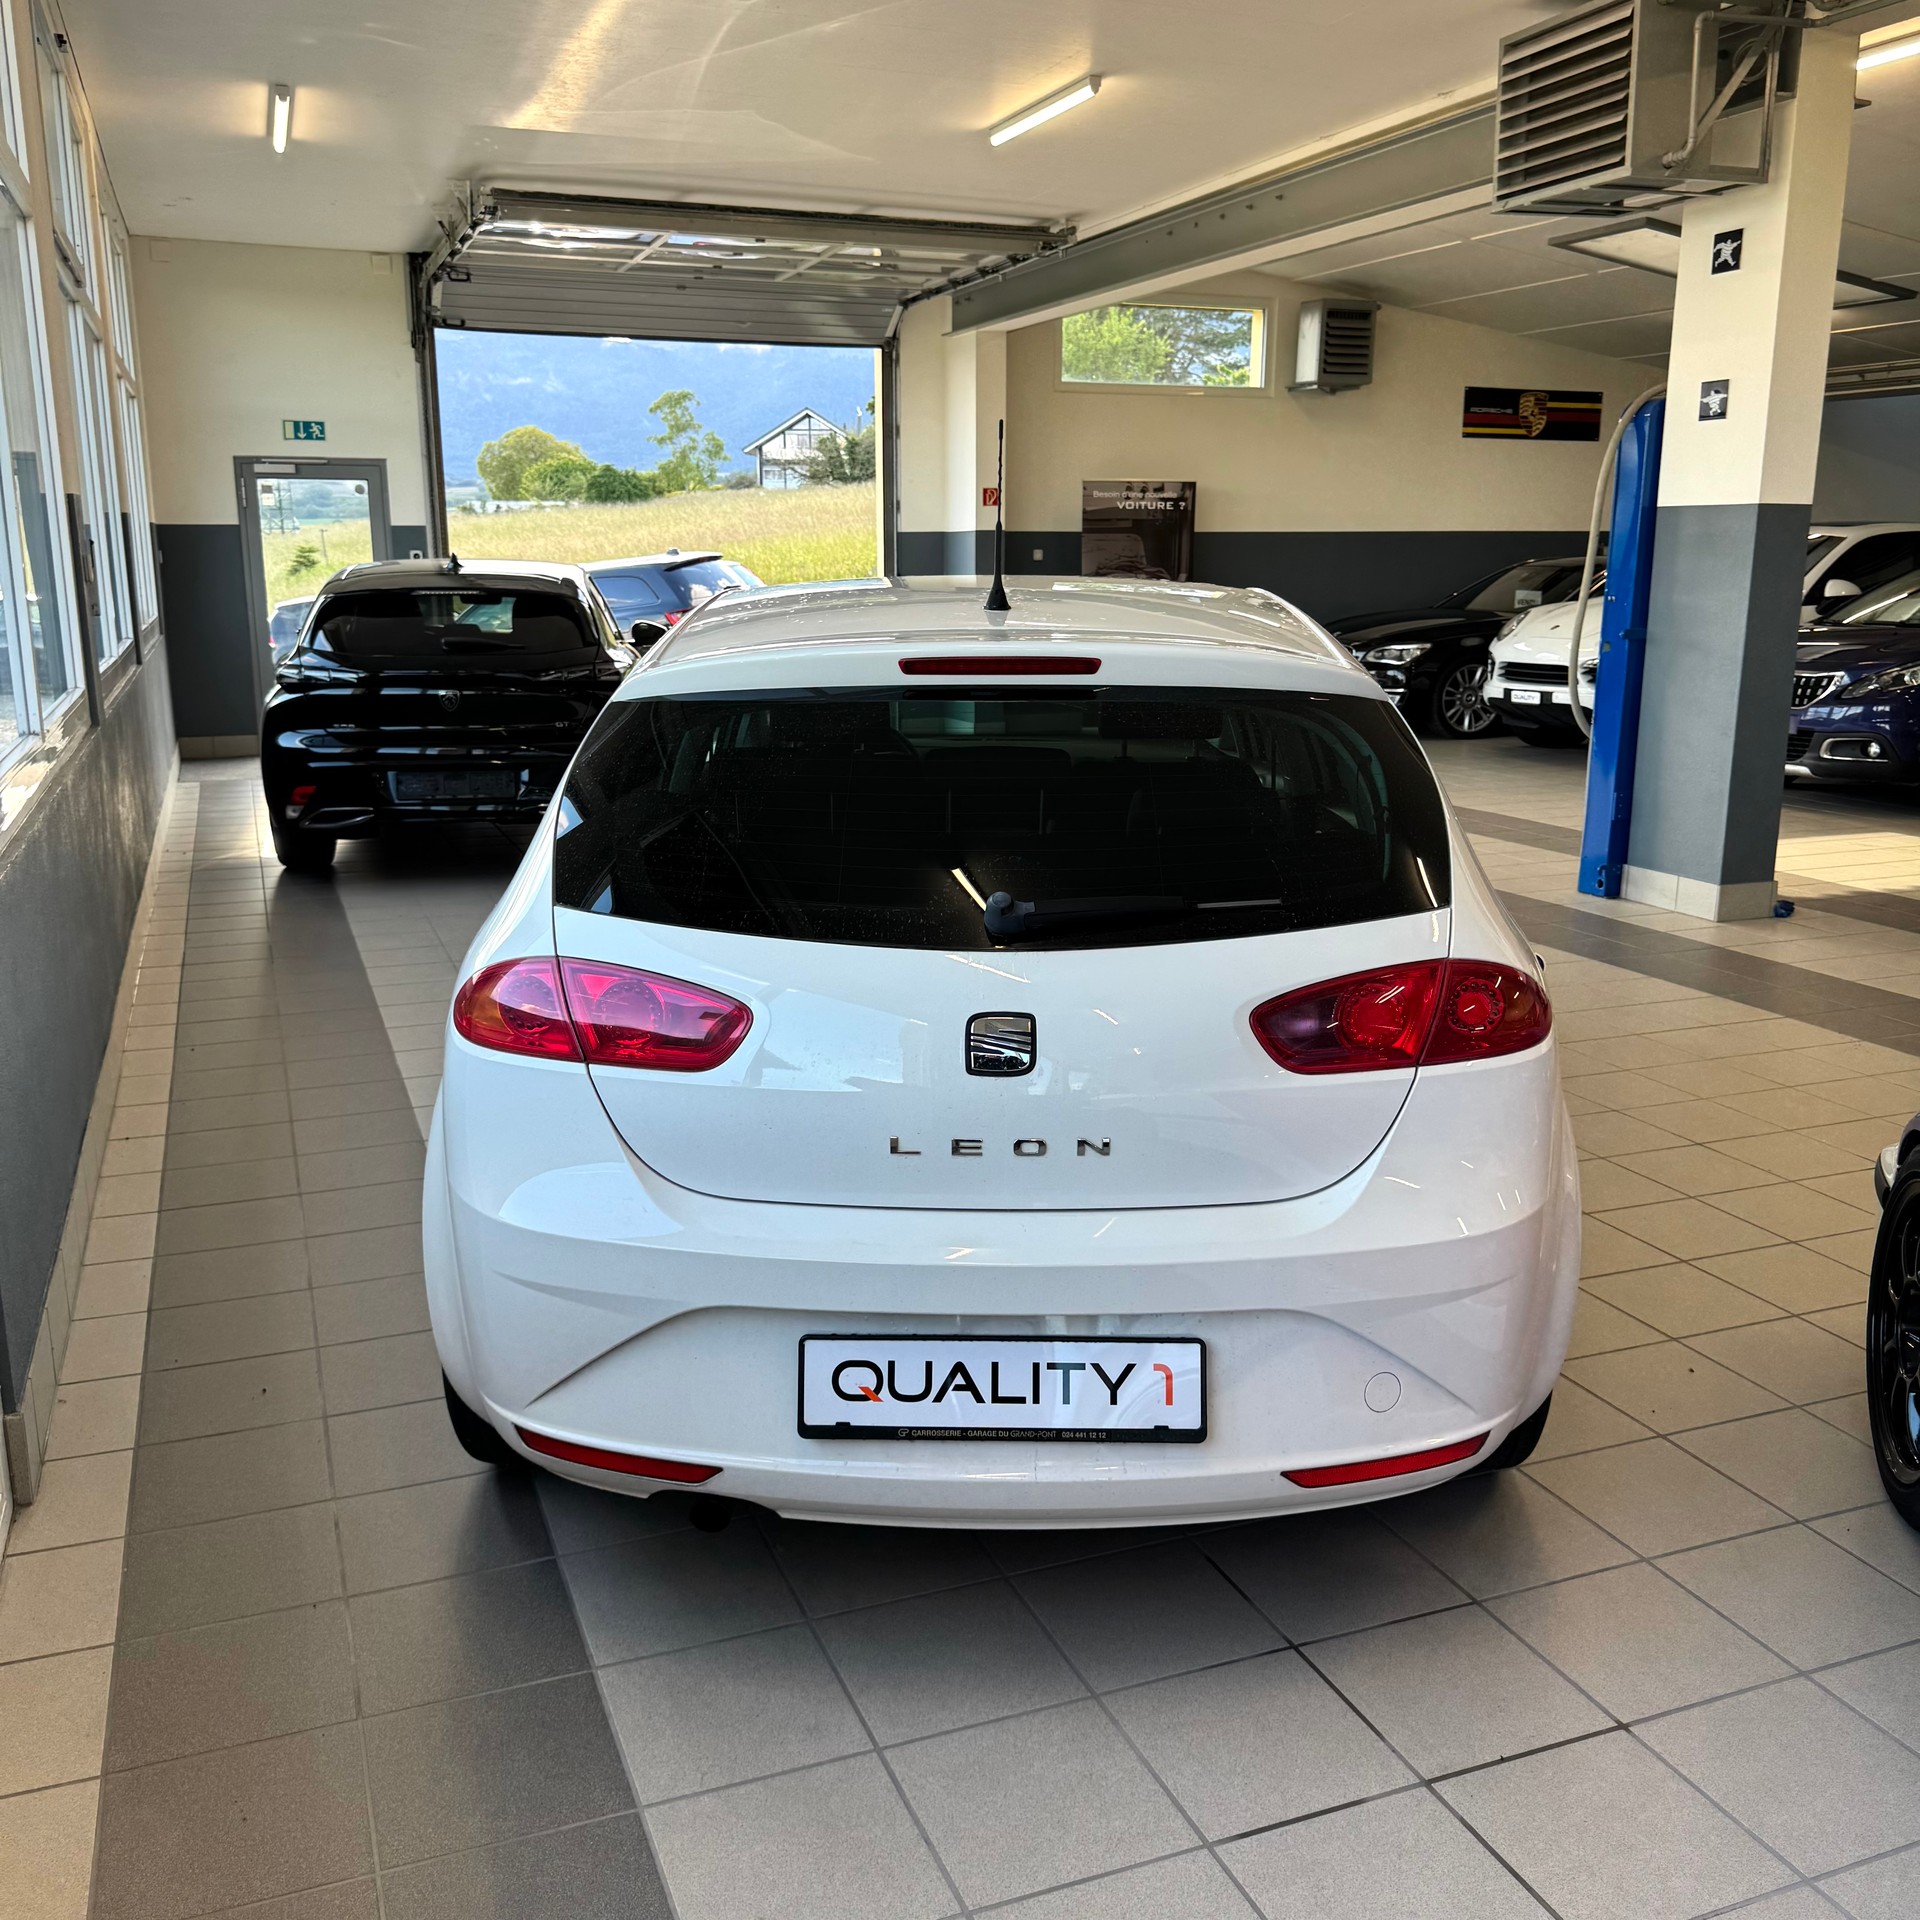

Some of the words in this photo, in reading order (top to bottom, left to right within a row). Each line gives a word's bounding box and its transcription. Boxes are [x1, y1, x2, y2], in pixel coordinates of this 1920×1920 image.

[1093, 490, 1120, 498] Besoin
[1122, 490, 1143, 499] d'une
[1145, 491, 1177, 499] nouvelle
[1117, 501, 1174, 510] VOITURE
[1179, 502, 1186, 510] ?
[889, 1136, 1112, 1157] LEON
[831, 1360, 1137, 1406] QUALITY
[911, 1429, 962, 1437] CARROSSERIE
[1010, 1430, 1057, 1438] GRAND-PONT
[1099, 1431, 1106, 1439] 12
